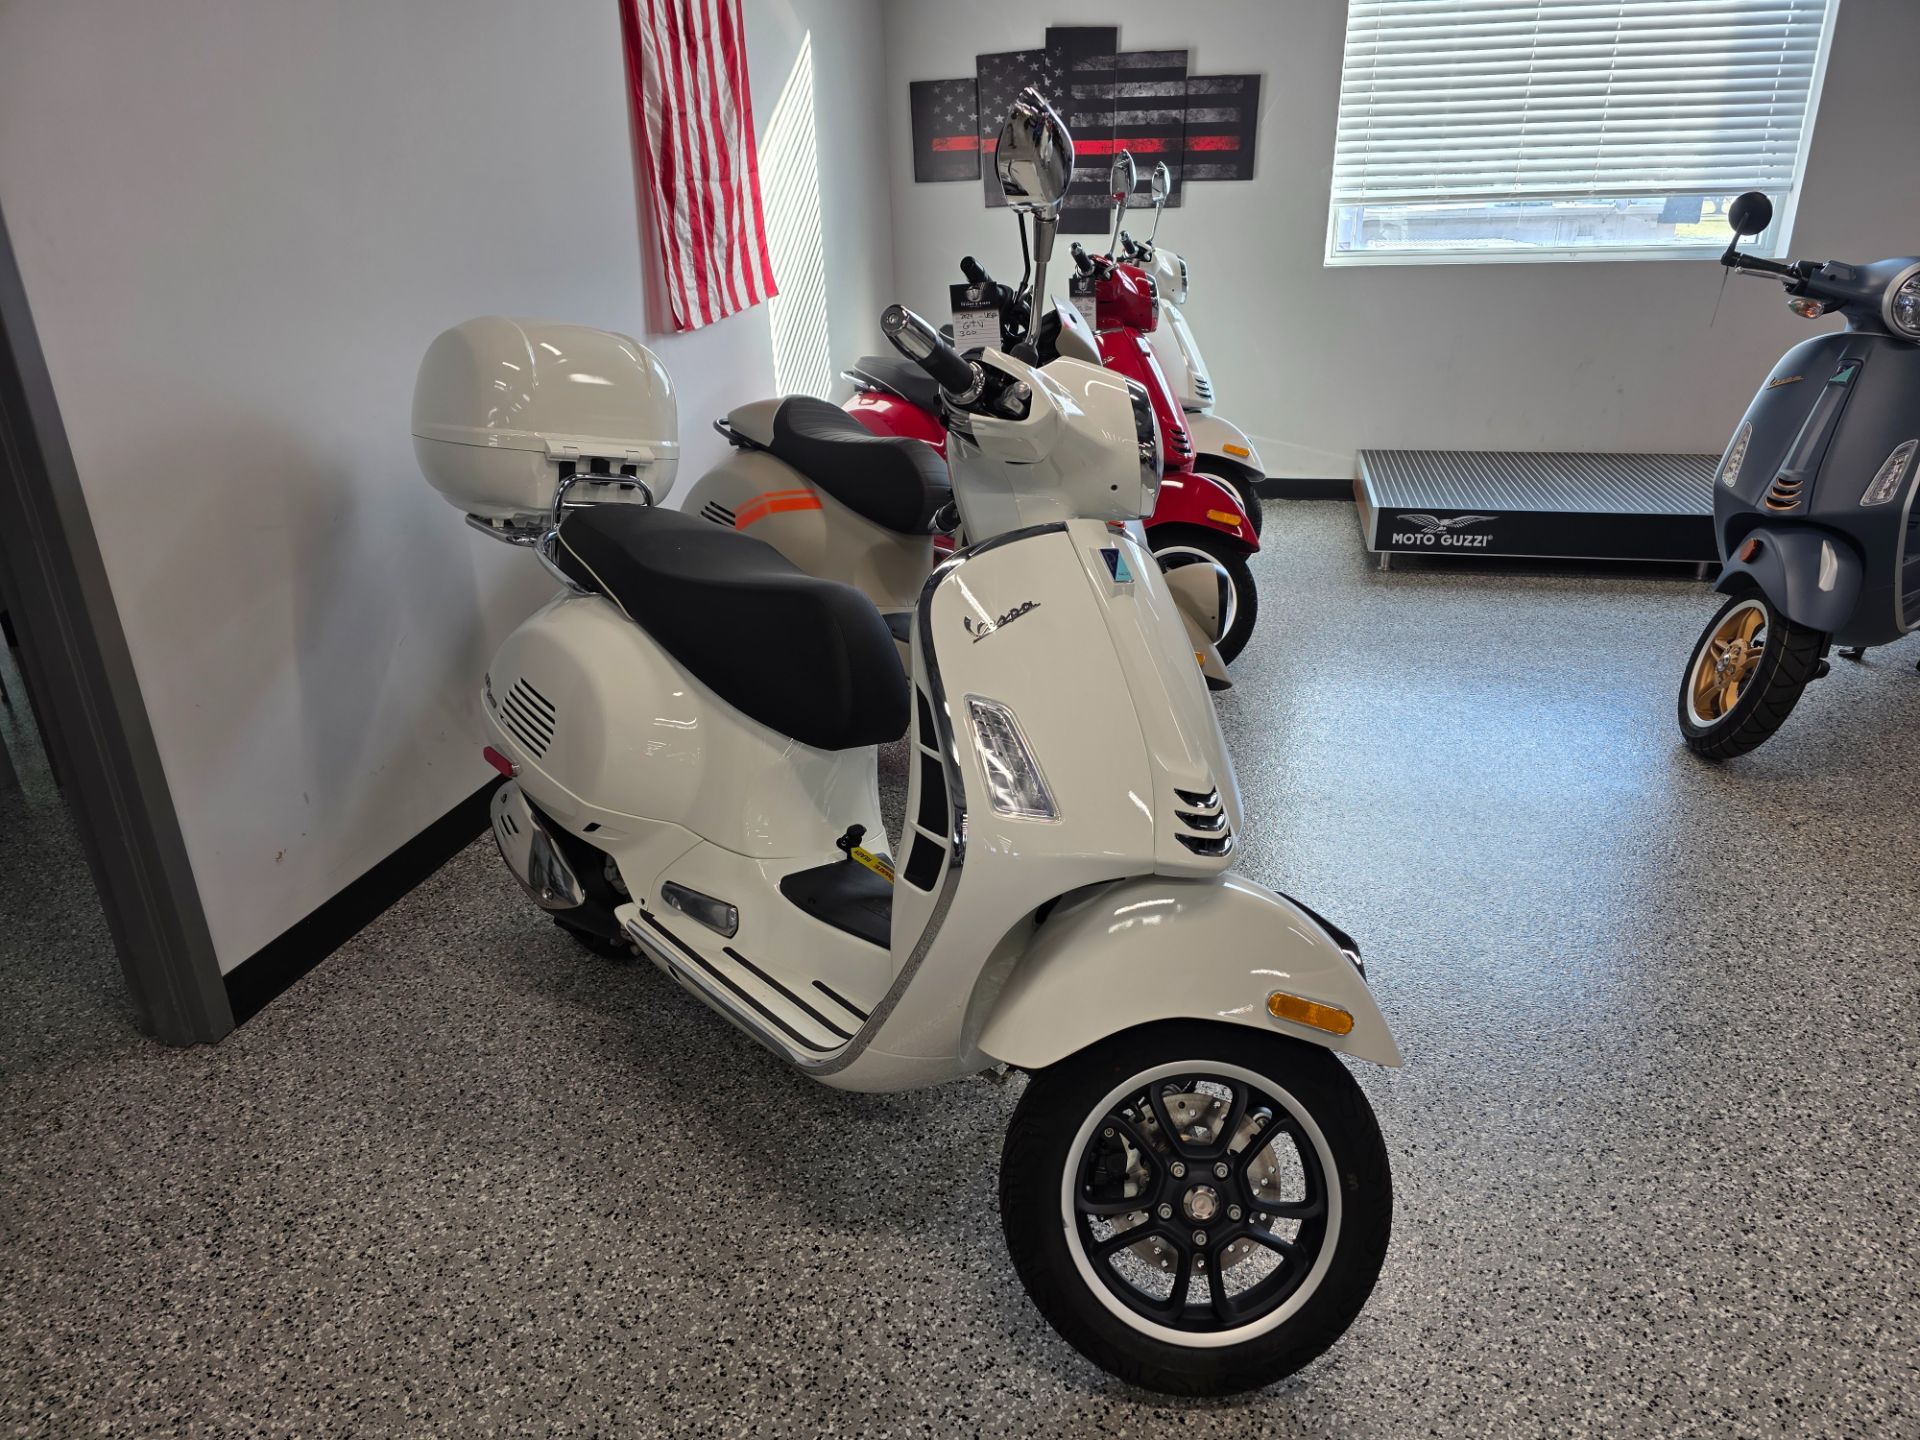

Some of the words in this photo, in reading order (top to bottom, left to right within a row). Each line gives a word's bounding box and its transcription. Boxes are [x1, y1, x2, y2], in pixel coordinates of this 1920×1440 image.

[1392, 532, 1436, 545] MOTO
[1440, 534, 1488, 547] GUZZI
[964, 600, 1041, 645] Vespa
